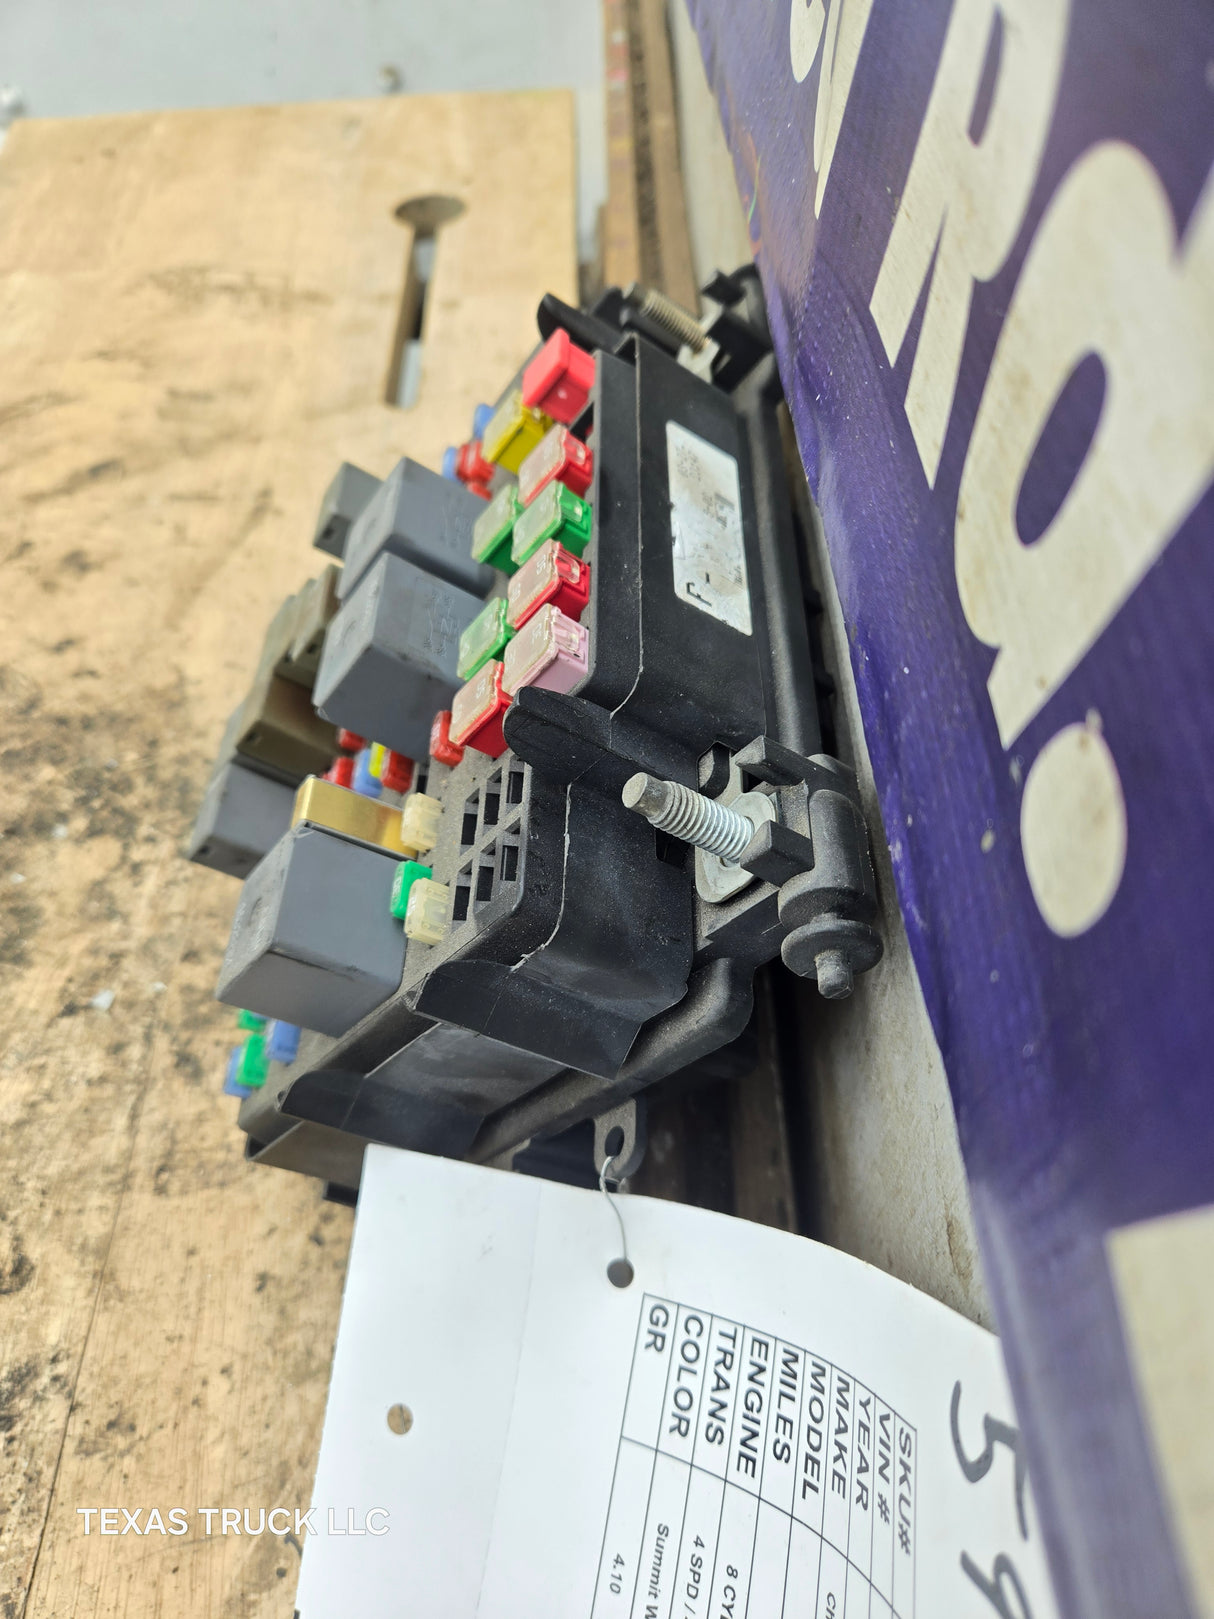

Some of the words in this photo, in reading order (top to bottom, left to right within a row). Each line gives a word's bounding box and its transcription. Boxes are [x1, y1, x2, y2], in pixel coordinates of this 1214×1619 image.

[645, 1303, 669, 1353] GR
[669, 1314, 704, 1438] COLOR
[705, 1327, 738, 1446] TRANS
[737, 1336, 769, 1479] ENGINE
[773, 1347, 799, 1464] MILES
[801, 1360, 826, 1500] MODEL
[832, 1375, 850, 1500] MAKE
[855, 1395, 871, 1511] YEAR
[878, 1412, 890, 1485] VIN
[898, 1426, 913, 1556] SKU#
[609, 1553, 625, 1594] 4.10
[648, 1523, 670, 1599] Summit
[686, 1553, 703, 1600] SPD
[693, 1534, 705, 1549] 4
[726, 1564, 738, 1579] 8
[720, 1584, 736, 1619] CY
